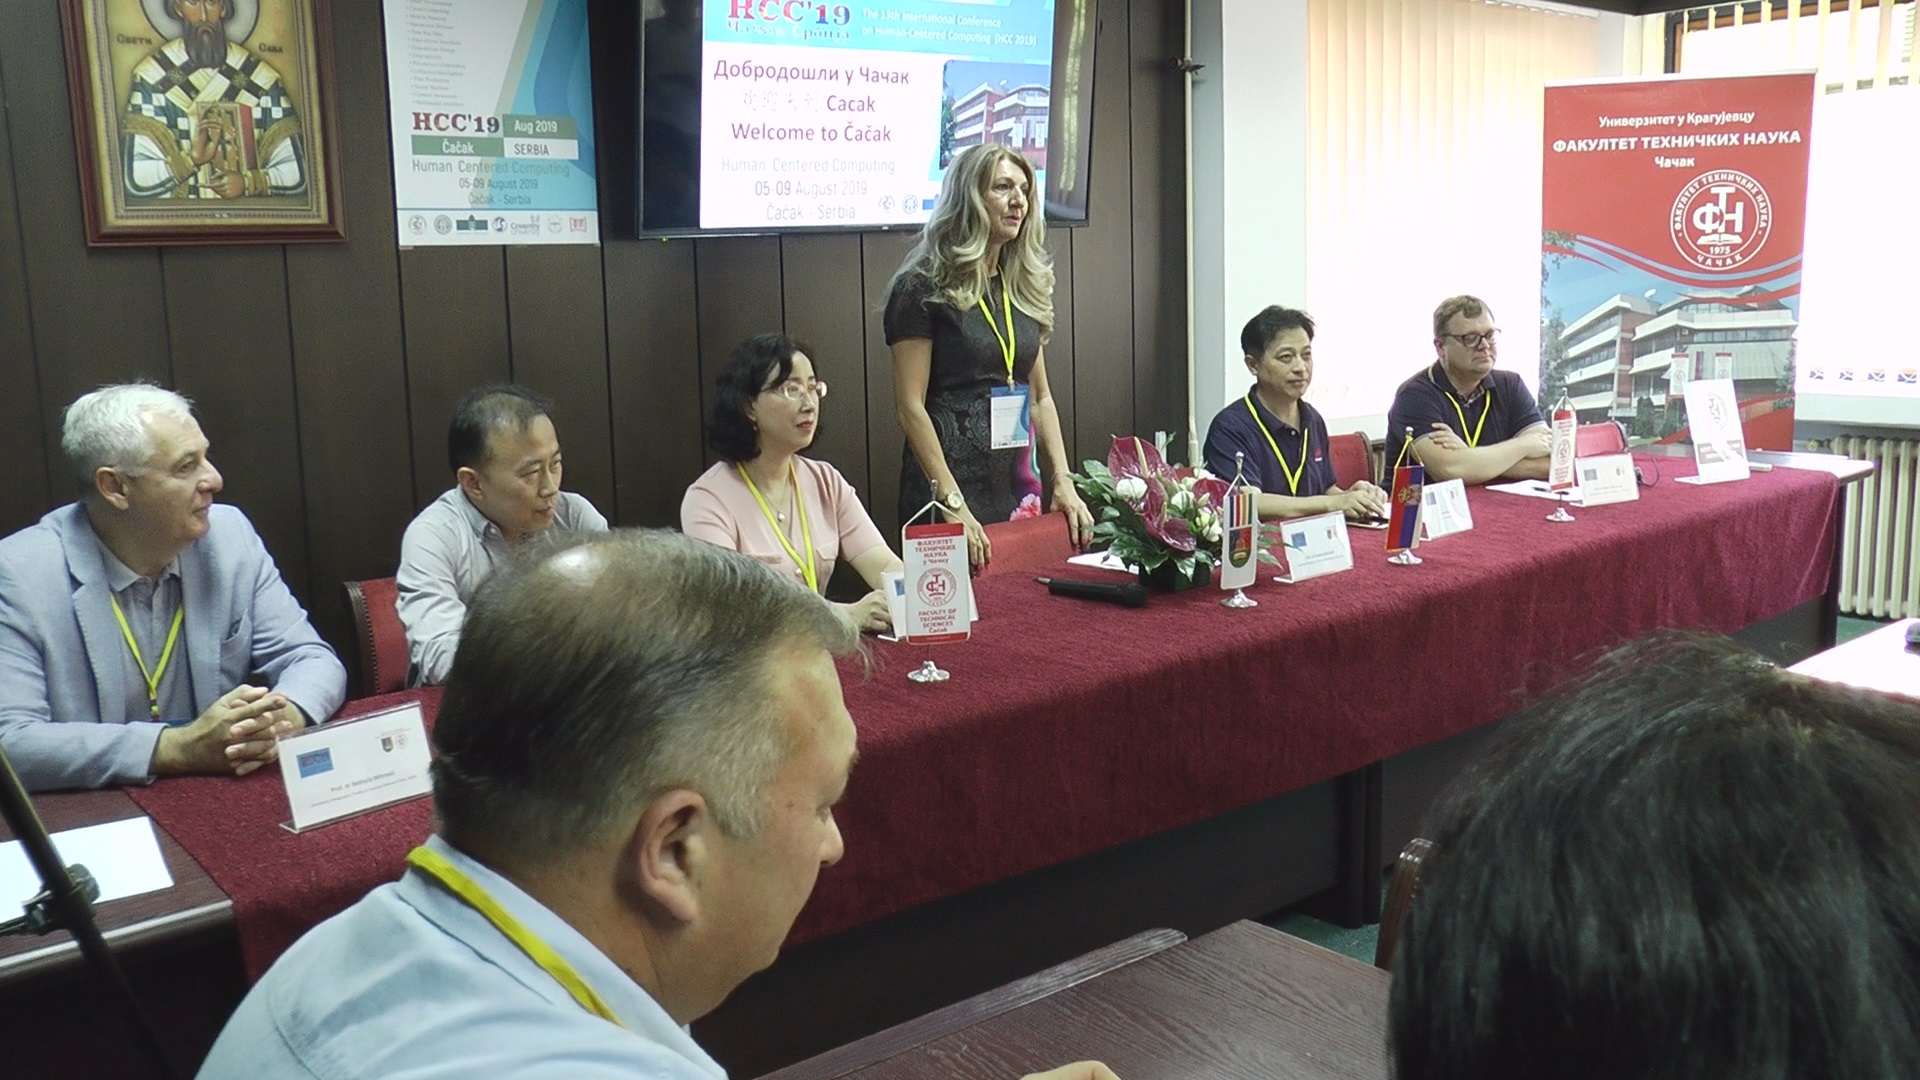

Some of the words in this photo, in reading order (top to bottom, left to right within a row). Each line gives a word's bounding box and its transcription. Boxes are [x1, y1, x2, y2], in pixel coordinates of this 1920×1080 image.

[728, 0, 850, 26] HCC'19
[862, 8, 879, 19] The
[902, 11, 956, 25] International
[957, 14, 1002, 28] Conference
[862, 27, 874, 36] on
[875, 26, 947, 40] Human-Centered
[948, 30, 991, 46] Computing
[994, 33, 1014, 46] (HCC
[1015, 35, 1037, 48] 2019)
[713, 60, 840, 83] Добродошли
[845, 70, 855, 86] у
[859, 66, 910, 85] Чачак
[827, 94, 876, 113] Cacak
[412, 112, 500, 133] HCC'19
[514, 119, 534, 134] Aug
[536, 120, 558, 133] 2019
[1599, 114, 1676, 129] Универзитет
[1677, 116, 1685, 128] у
[1686, 110, 1755, 127] Крагујевцу
[731, 122, 815, 142] Welcome
[821, 126, 838, 142] to
[844, 120, 892, 143] Čačak
[442, 141, 475, 155] Čačak
[514, 143, 550, 156] SERBIA
[1552, 136, 1639, 153] ФАКУЛТЕТ
[1641, 132, 1740, 150] ТЕХНИЧКИХ
[1743, 130, 1802, 145] НАУКА
[412, 159, 453, 173] Human
[458, 160, 509, 175] Centered
[512, 161, 571, 178] Computing
[721, 157, 766, 173] Human
[772, 157, 829, 173] Centered
[832, 157, 896, 176] Computing
[1654, 155, 1696, 169] Чачак
[459, 178, 485, 190] 05-09
[487, 178, 518, 192] August
[519, 179, 539, 190] 2019
[754, 181, 792, 196] 05-09
[795, 180, 838, 199] August
[842, 180, 868, 196] 2019
[503, 193, 532, 205] Serbia
[817, 203, 856, 221] Serbia
[1709, 245, 1731, 255] 1975
[1695, 254, 1743, 268] ЧАЧАК
[918, 609, 947, 617] FACULTY
[920, 614, 956, 623] TECHNICAL
[922, 621, 953, 629] SCIENCES
